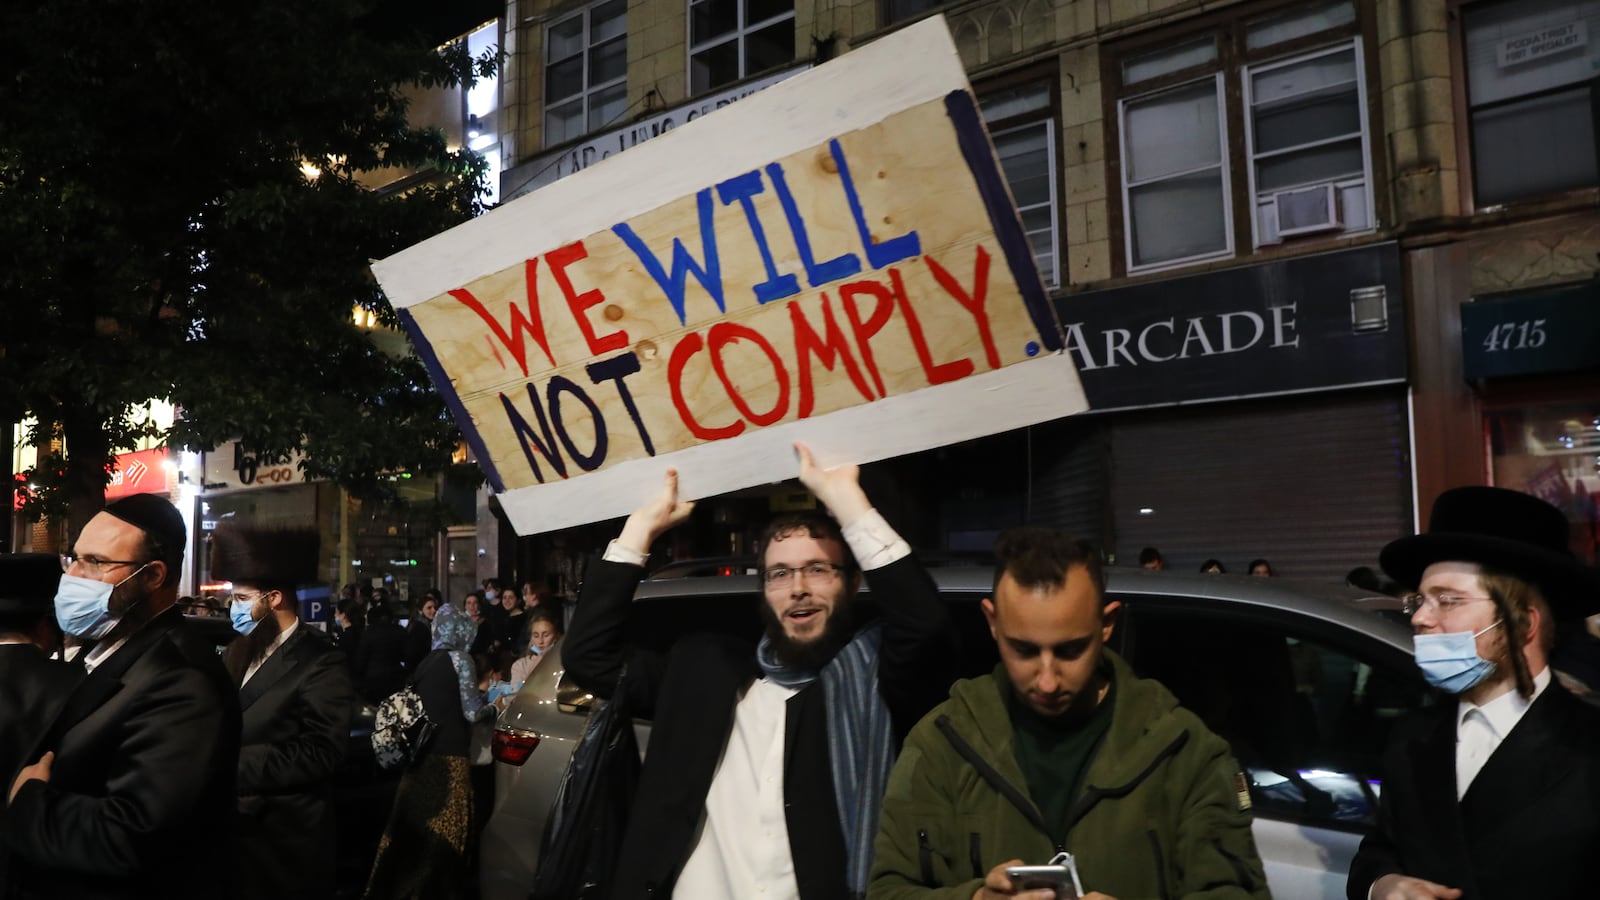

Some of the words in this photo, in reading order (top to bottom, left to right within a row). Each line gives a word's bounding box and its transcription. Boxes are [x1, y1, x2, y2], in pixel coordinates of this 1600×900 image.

[447, 240, 630, 378] WE
[611, 139, 921, 325] WILL
[1483, 318, 1547, 354] 4715
[500, 351, 656, 484] NOT
[311, 601, 322, 620] P
